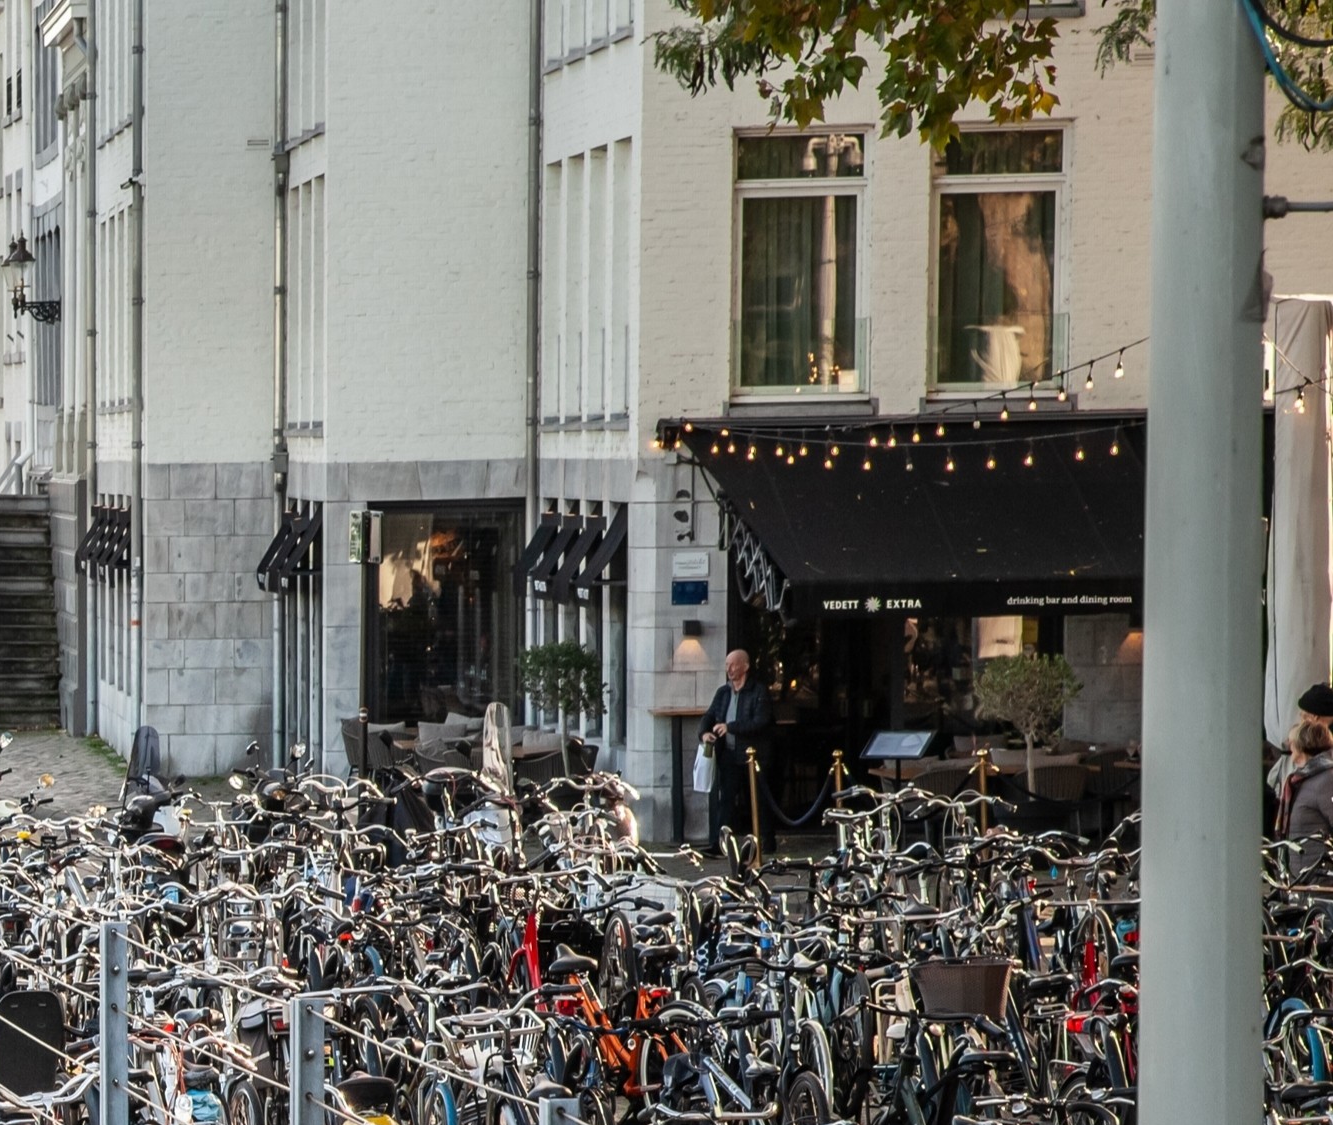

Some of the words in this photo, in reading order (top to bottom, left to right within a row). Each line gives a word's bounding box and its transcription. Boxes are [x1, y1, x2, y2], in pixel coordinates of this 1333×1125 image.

[823, 600, 859, 610] VEDETT
[886, 599, 922, 609] EXTRA
[1007, 596, 1044, 606] drinking
[1046, 596, 1060, 604] bar
[1062, 595, 1078, 604] and
[1080, 595, 1108, 605] dining
